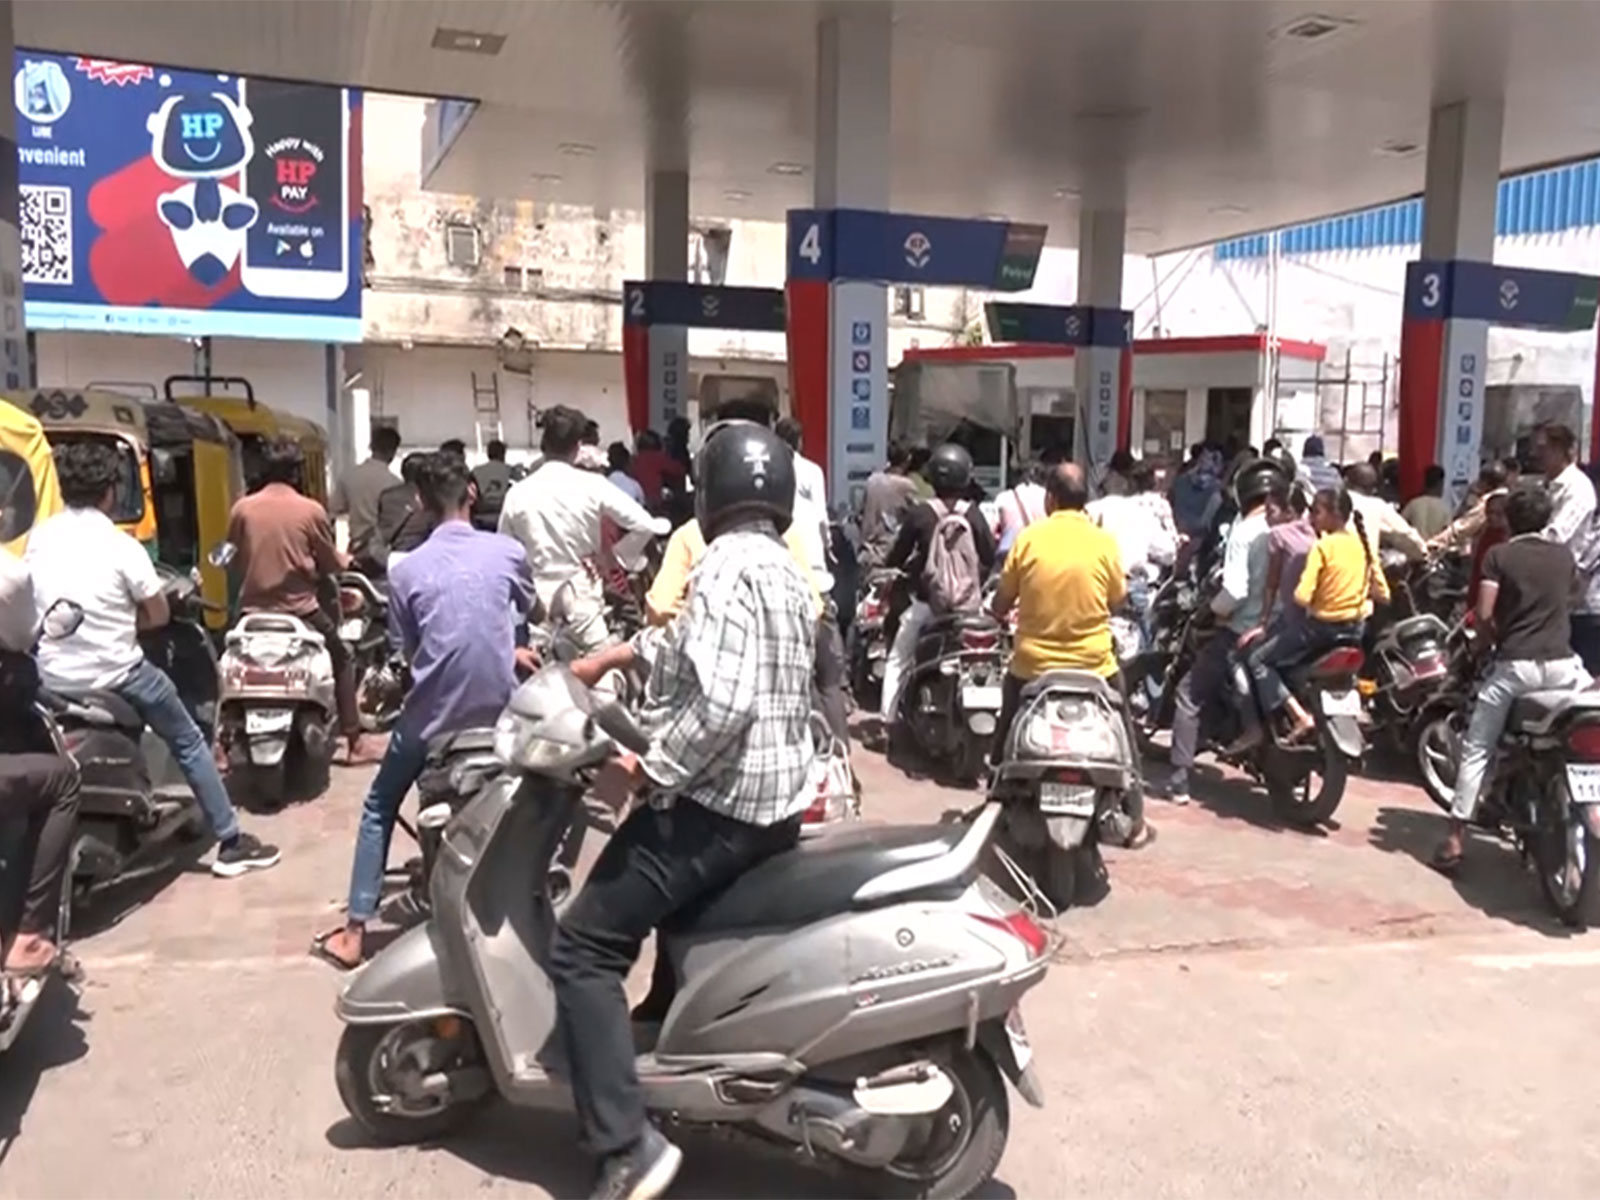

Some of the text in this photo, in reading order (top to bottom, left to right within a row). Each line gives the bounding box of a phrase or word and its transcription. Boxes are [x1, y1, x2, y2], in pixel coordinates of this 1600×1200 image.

[181, 113, 223, 139] HP
[275, 159, 316, 185] HP
[281, 185, 308, 199] PAY
[799, 223, 821, 265] 4
[630, 288, 646, 316] 2
[1422, 273, 1440, 308] 3
[1122, 319, 1132, 343] 1
